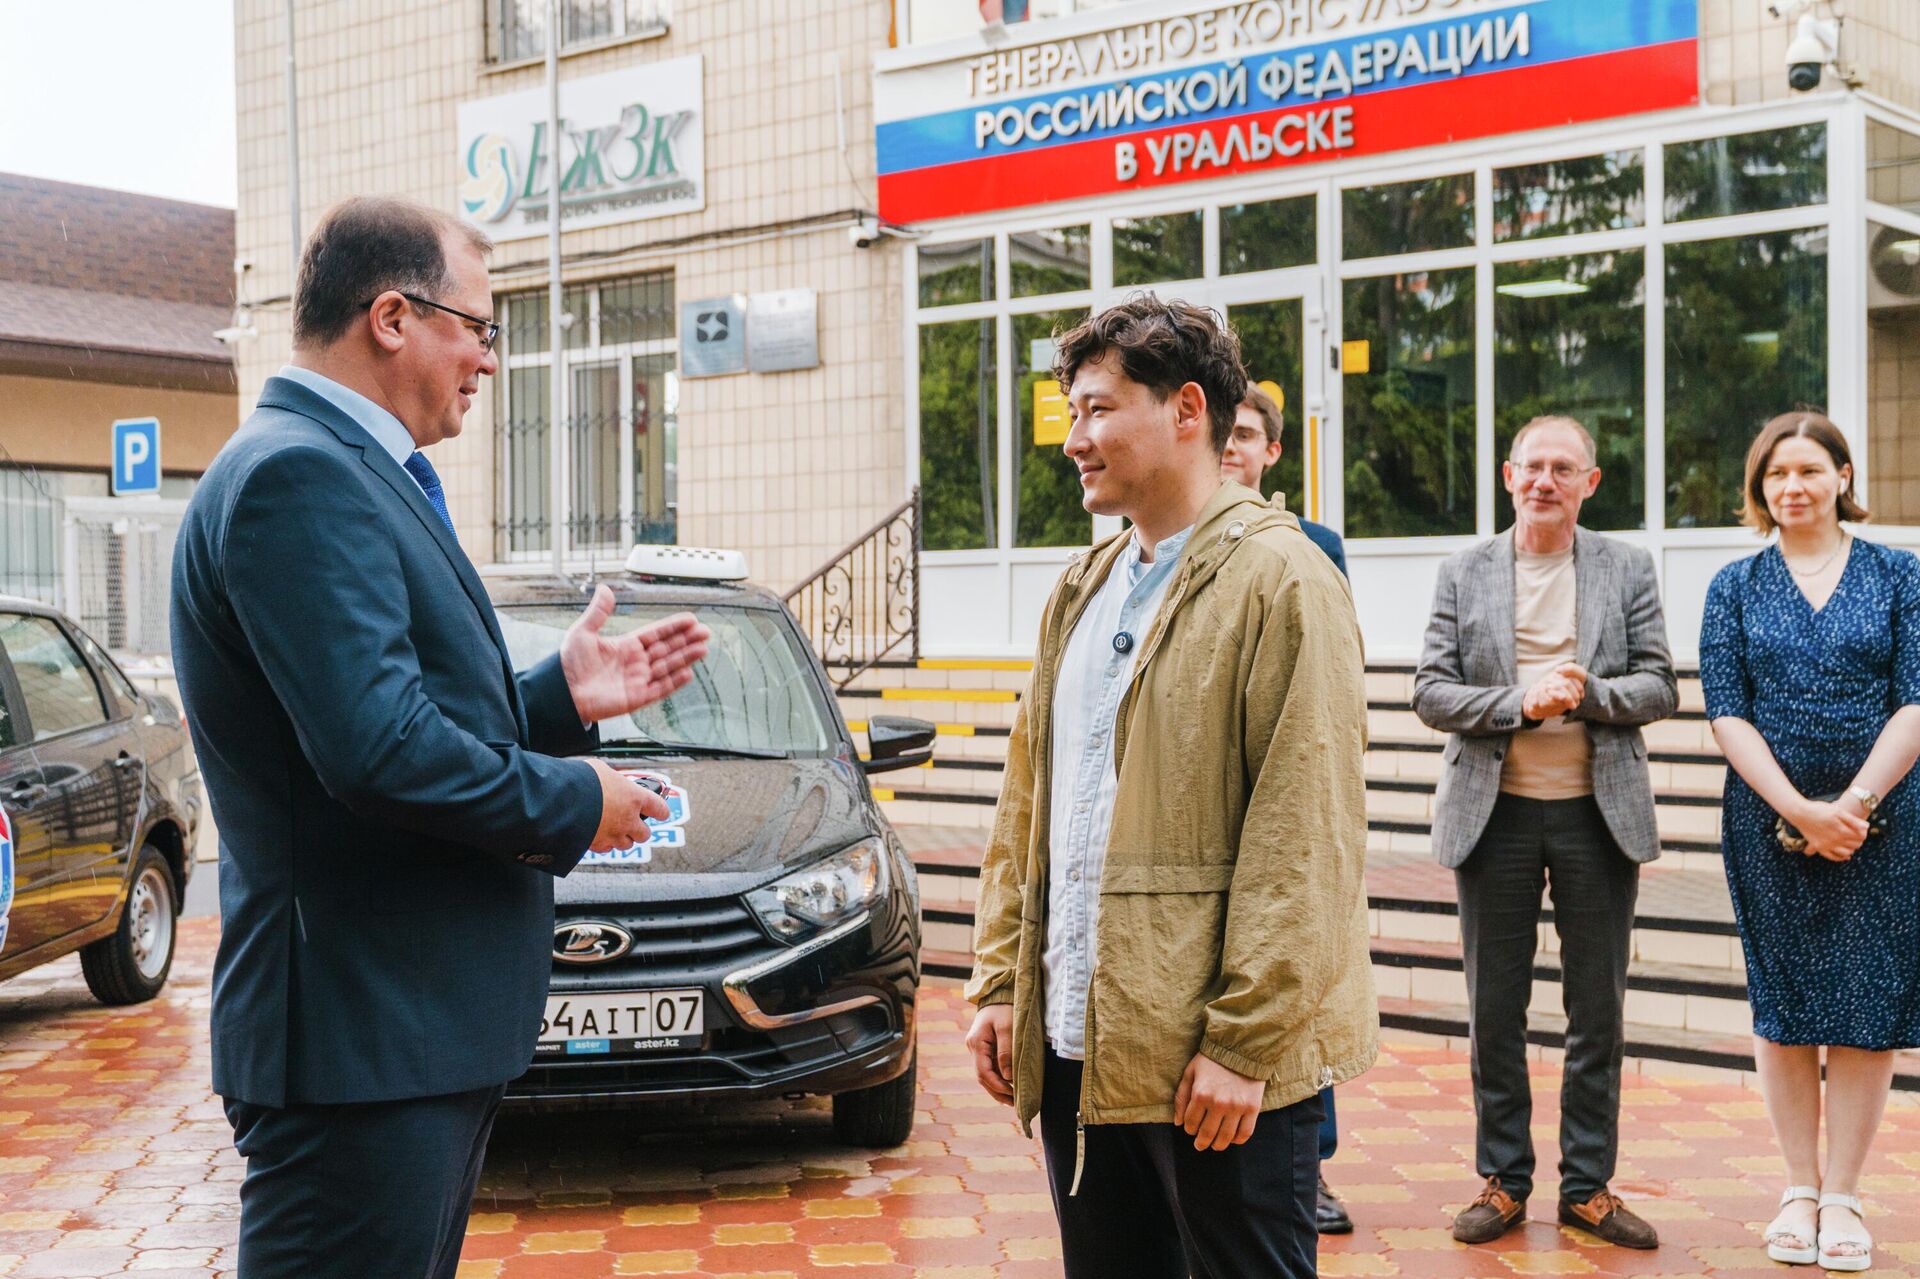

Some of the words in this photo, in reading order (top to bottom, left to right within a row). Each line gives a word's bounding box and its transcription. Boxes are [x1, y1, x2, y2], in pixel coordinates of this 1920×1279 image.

[967, 9, 1218, 97] ГЕНЕРАЛЬНОЕ
[974, 57, 1248, 149] РОССИЙСКОЙ
[1257, 11, 1531, 100] ФЕДЕРАЦИИ
[1115, 141, 1139, 181] В
[1145, 105, 1355, 176] УРАЛЬСКЕ
[124, 431, 149, 483] P
[634, 1038, 680, 1050] aster.kz
[656, 996, 700, 1032] 07
